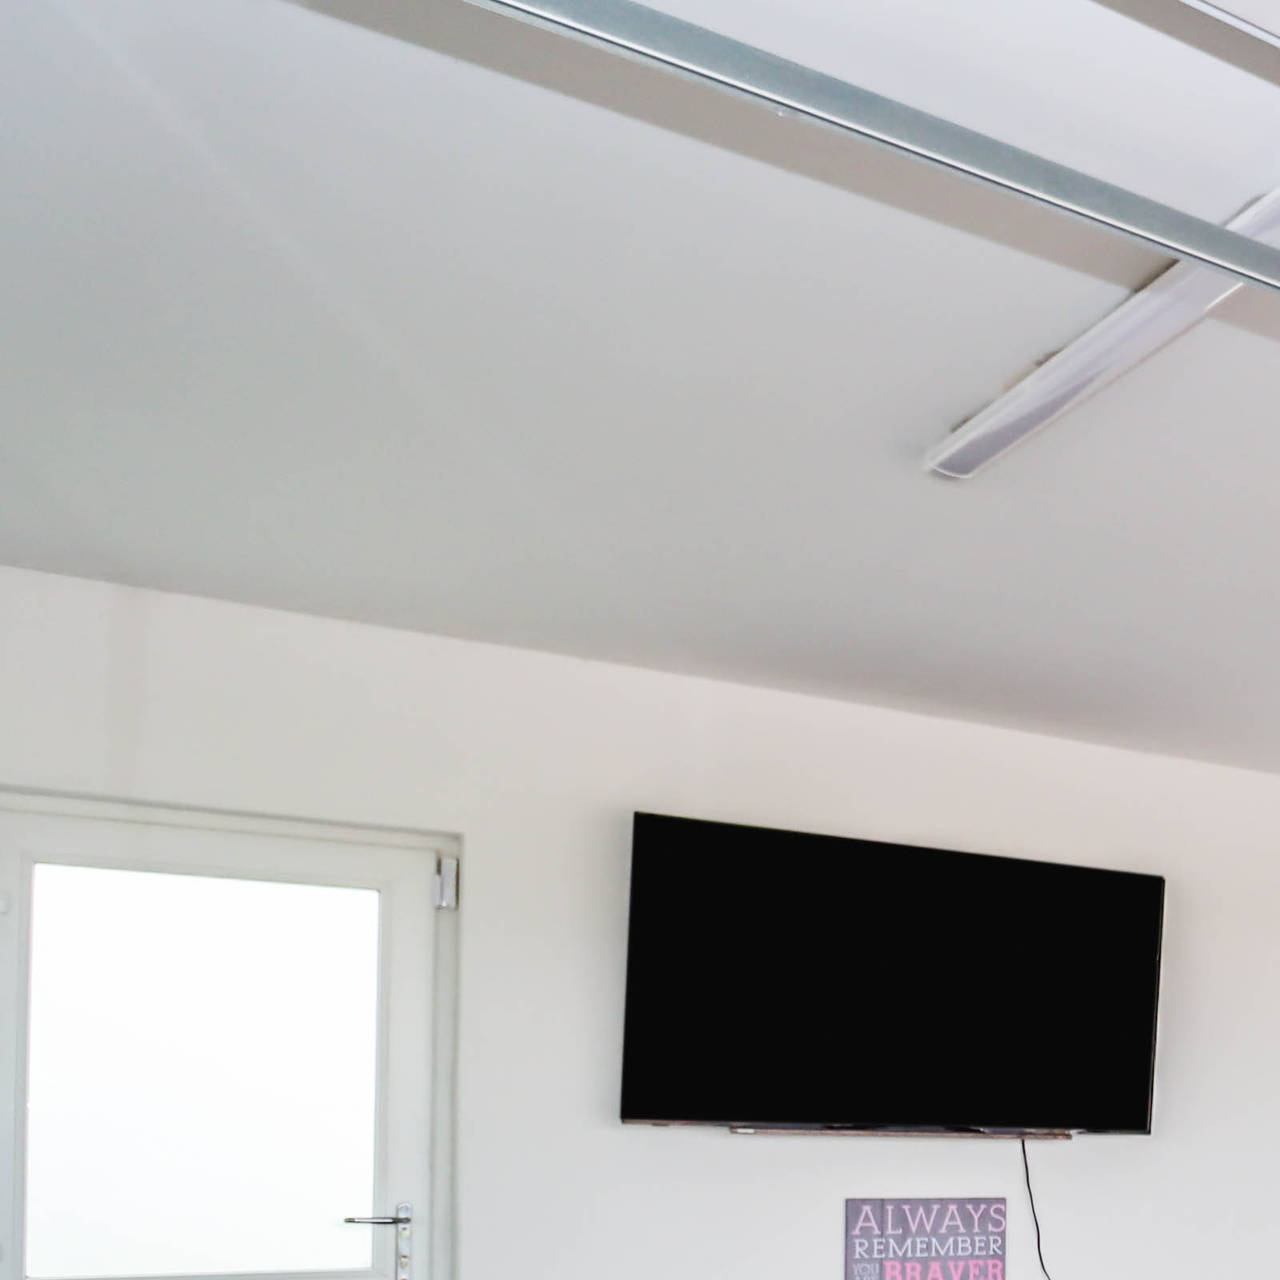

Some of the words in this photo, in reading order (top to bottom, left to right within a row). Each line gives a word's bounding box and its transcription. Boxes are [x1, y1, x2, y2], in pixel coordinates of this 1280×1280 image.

[852, 1204, 1006, 1235] ALWAYS
[853, 1236, 1002, 1259] REMEMBER
[852, 1263, 880, 1276] YOU
